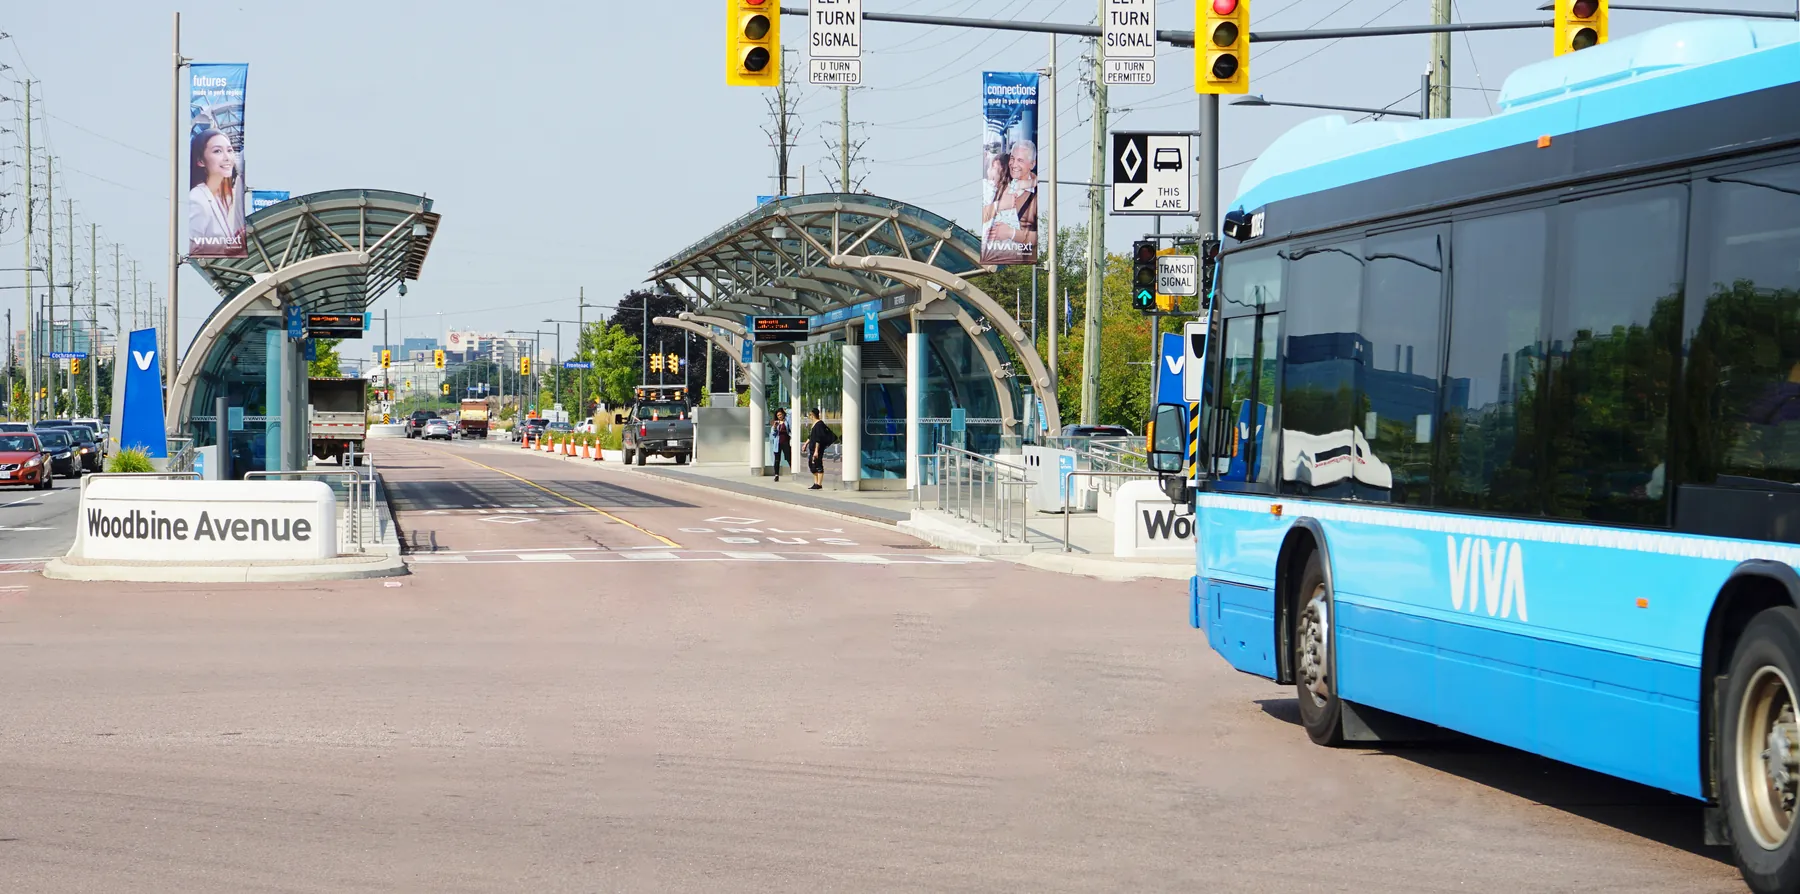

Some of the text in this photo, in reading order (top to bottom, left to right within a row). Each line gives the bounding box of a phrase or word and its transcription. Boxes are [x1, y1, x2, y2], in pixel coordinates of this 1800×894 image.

[816, 11, 855, 25] TURN
[1111, 11, 1149, 25] TURN
[812, 32, 858, 46] SIGNAL
[1107, 32, 1152, 46] SIGNAL
[820, 62, 850, 70] U TURN
[1115, 62, 1144, 70] U TURN
[193, 75, 227, 87] futures
[813, 73, 857, 81] PERMITTED
[1108, 73, 1152, 81] PERMITTED
[987, 84, 1036, 95] connections
[1158, 187, 1180, 197] THIS
[1155, 199, 1182, 208] LANE
[1159, 264, 1194, 274] TRANSIT
[1161, 277, 1192, 287] SIGNAL
[87, 508, 312, 541] Woodbine Avenue
[717, 536, 859, 546] BUS
[1447, 534, 1528, 622] VIVA
